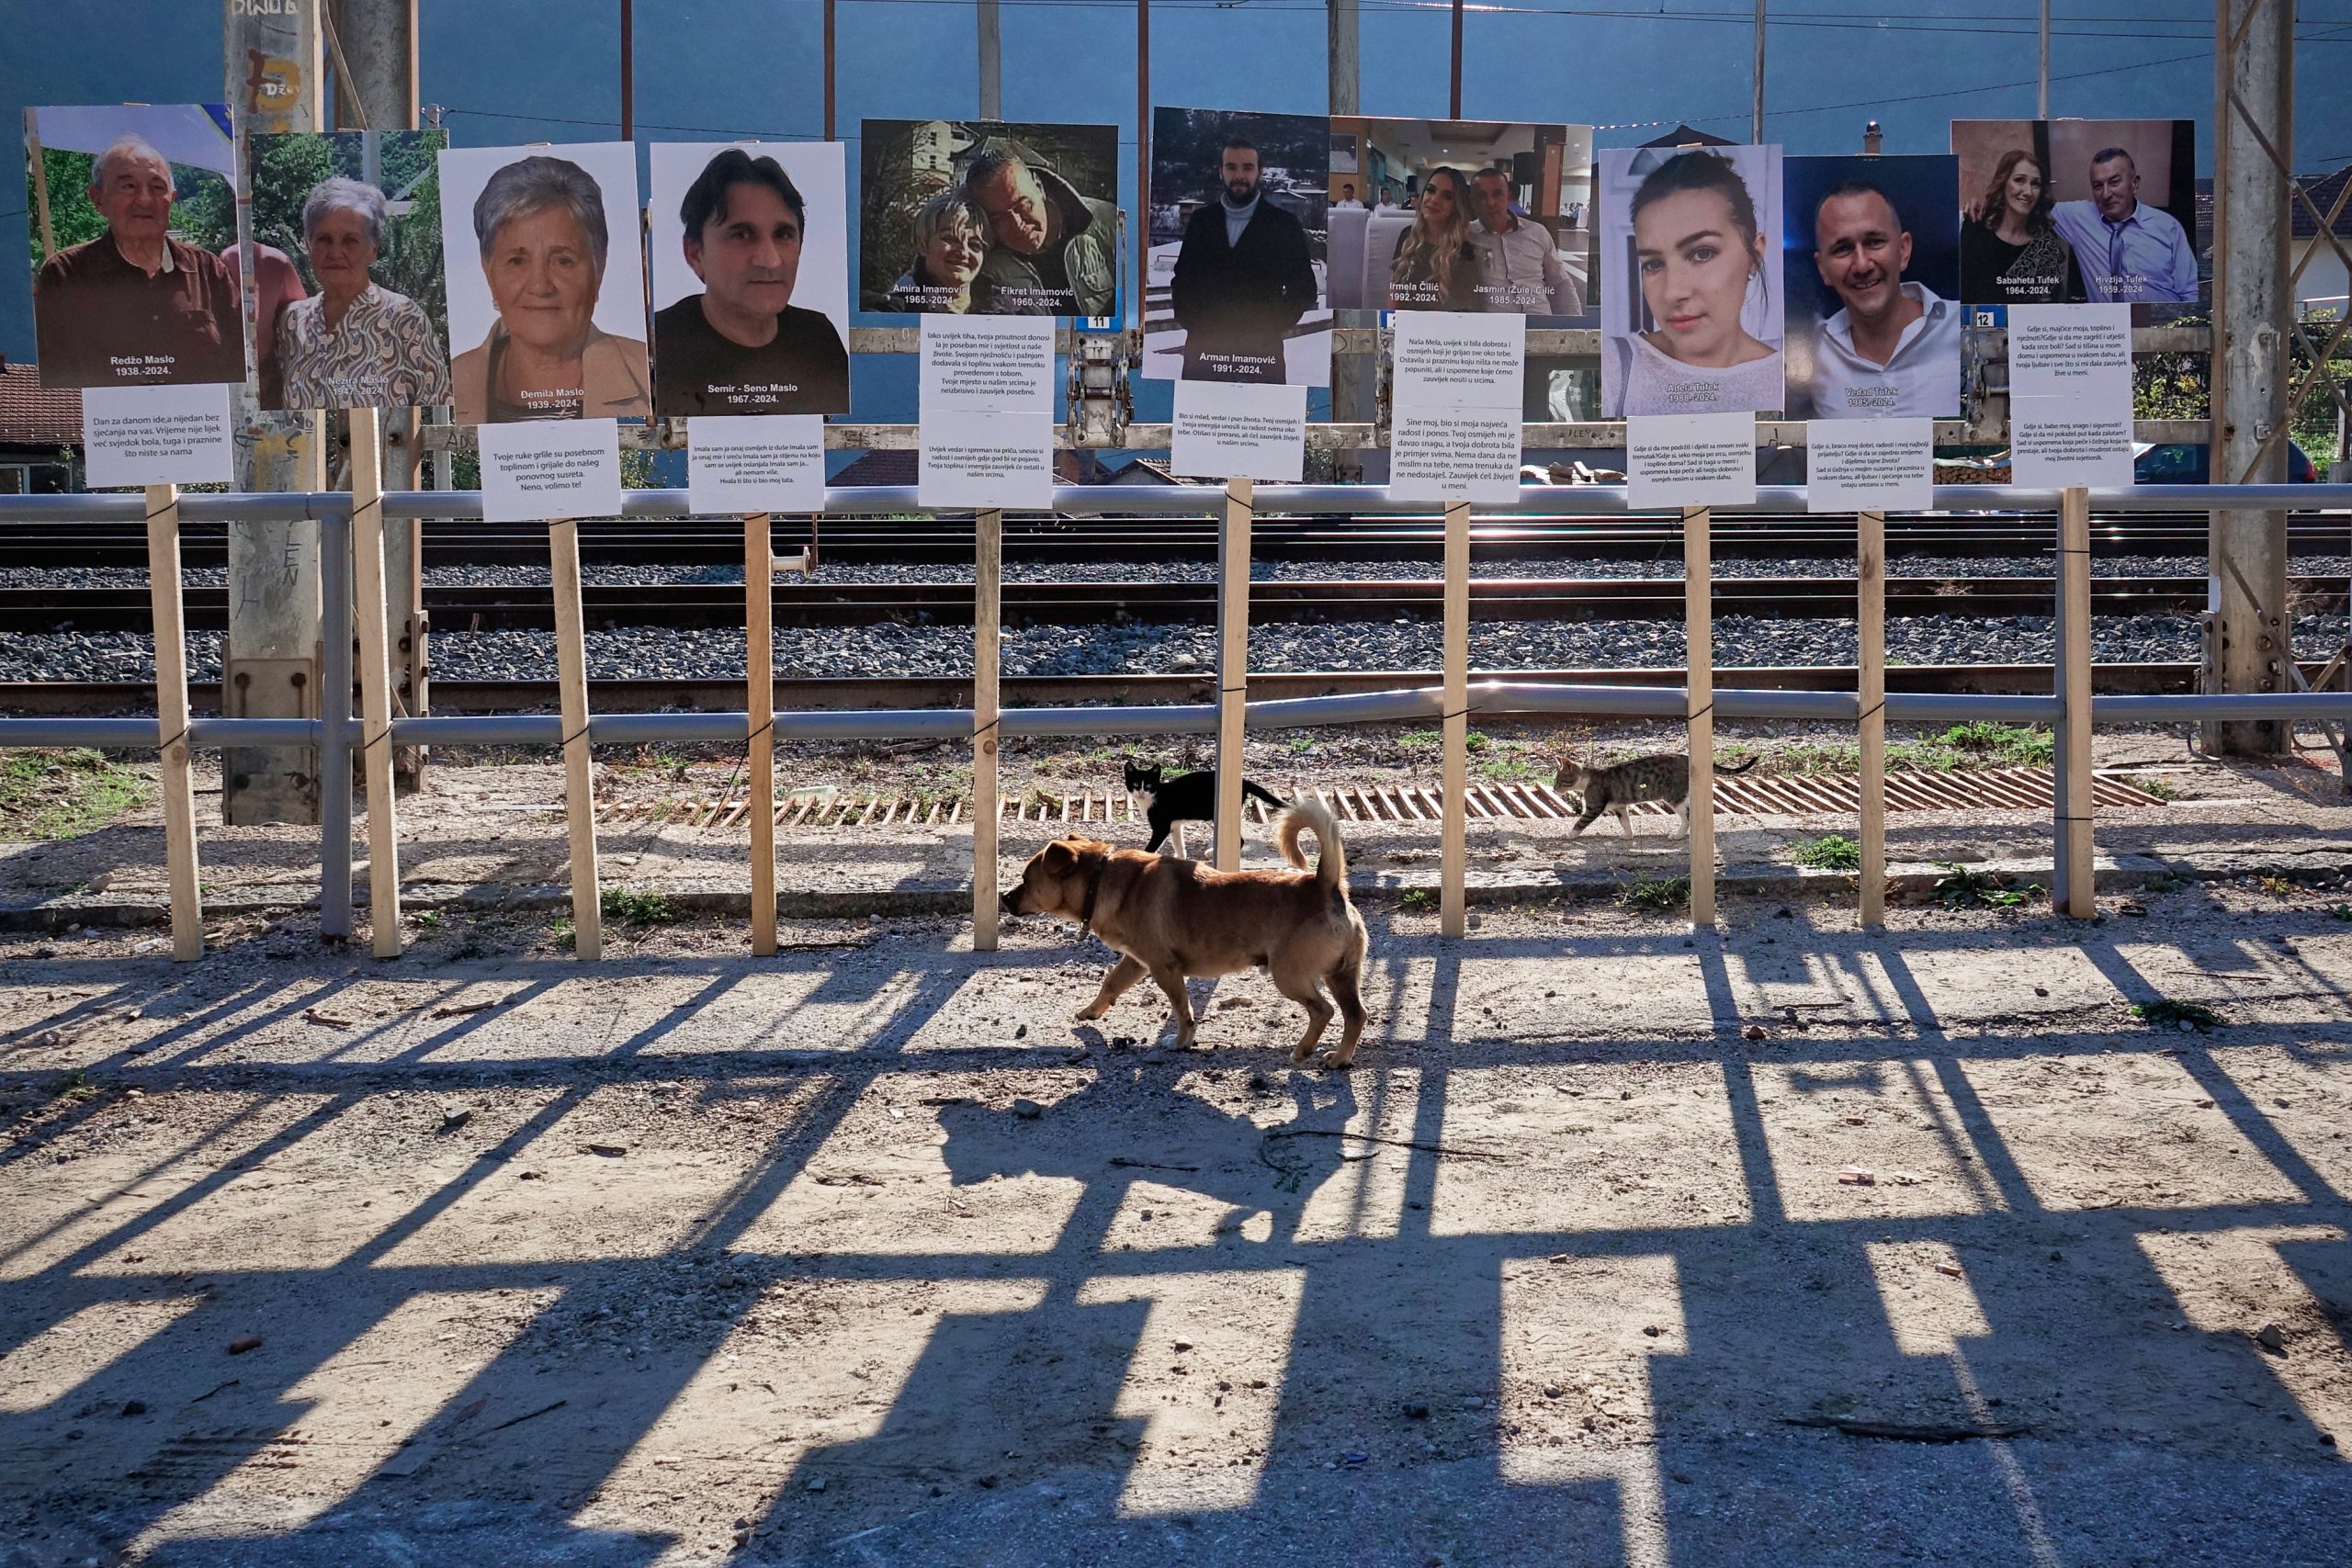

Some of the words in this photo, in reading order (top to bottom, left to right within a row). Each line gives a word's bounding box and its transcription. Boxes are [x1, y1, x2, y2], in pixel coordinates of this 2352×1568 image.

[1996, 276, 2034, 285] Sabaheta
[2036, 276, 2060, 285] Tufek
[2096, 276, 2122, 285] Hivzija
[893, 285, 921, 293] Amira
[1390, 282, 1417, 291] Irmela
[1474, 285, 1506, 294] Jasmin
[1001, 288, 1027, 296] Fikret
[1030, 288, 1073, 297] Imamović
[2006, 287, 2051, 296] 1964.-2024.
[1389, 292, 1439, 302] 1992.-2024.
[1012, 298, 1062, 307] 1960.-2024.
[1093, 317, 1104, 327] 11
[1978, 315, 1989, 325] 12
[110, 355, 142, 365] Redžo
[145, 355, 175, 364] Maslo
[1200, 353, 1229, 363] Arman
[1232, 354, 1275, 364] Imamović
[116, 367, 171, 377] 1938.-2024.
[1212, 364, 1262, 374] 1991.-2024.
[359, 376, 389, 384] Maslo
[707, 384, 735, 392] Semir
[743, 384, 767, 392] Seno
[1694, 382, 1719, 390] Tufek
[556, 388, 584, 397] Maslo
[1874, 388, 1898, 397] Tufek
[728, 395, 779, 403] 1967.-2024.
[527, 399, 580, 409] 1939.-2024.
[93, 417, 110, 425] Dan
[122, 416, 152, 424] danom
[153, 415, 172, 424] ide,a
[174, 414, 203, 424] nijedan
[205, 413, 220, 422] bez
[155, 426, 187, 435] Vrijeme
[188, 425, 203, 434] nije
[204, 424, 220, 434] lijek
[108, 438, 140, 448] svjedok
[163, 438, 182, 446] tuga
[187, 436, 222, 446] praznine
[493, 453, 514, 462] Tvoje
[533, 450, 553, 460] grlile
[564, 447, 605, 458] posebnom
[500, 462, 535, 472] toplinom
[540, 461, 564, 470] grijale
[515, 473, 555, 482] ponovnog
[544, 481, 571, 490] volimo
[571, 480, 582, 489] te!
